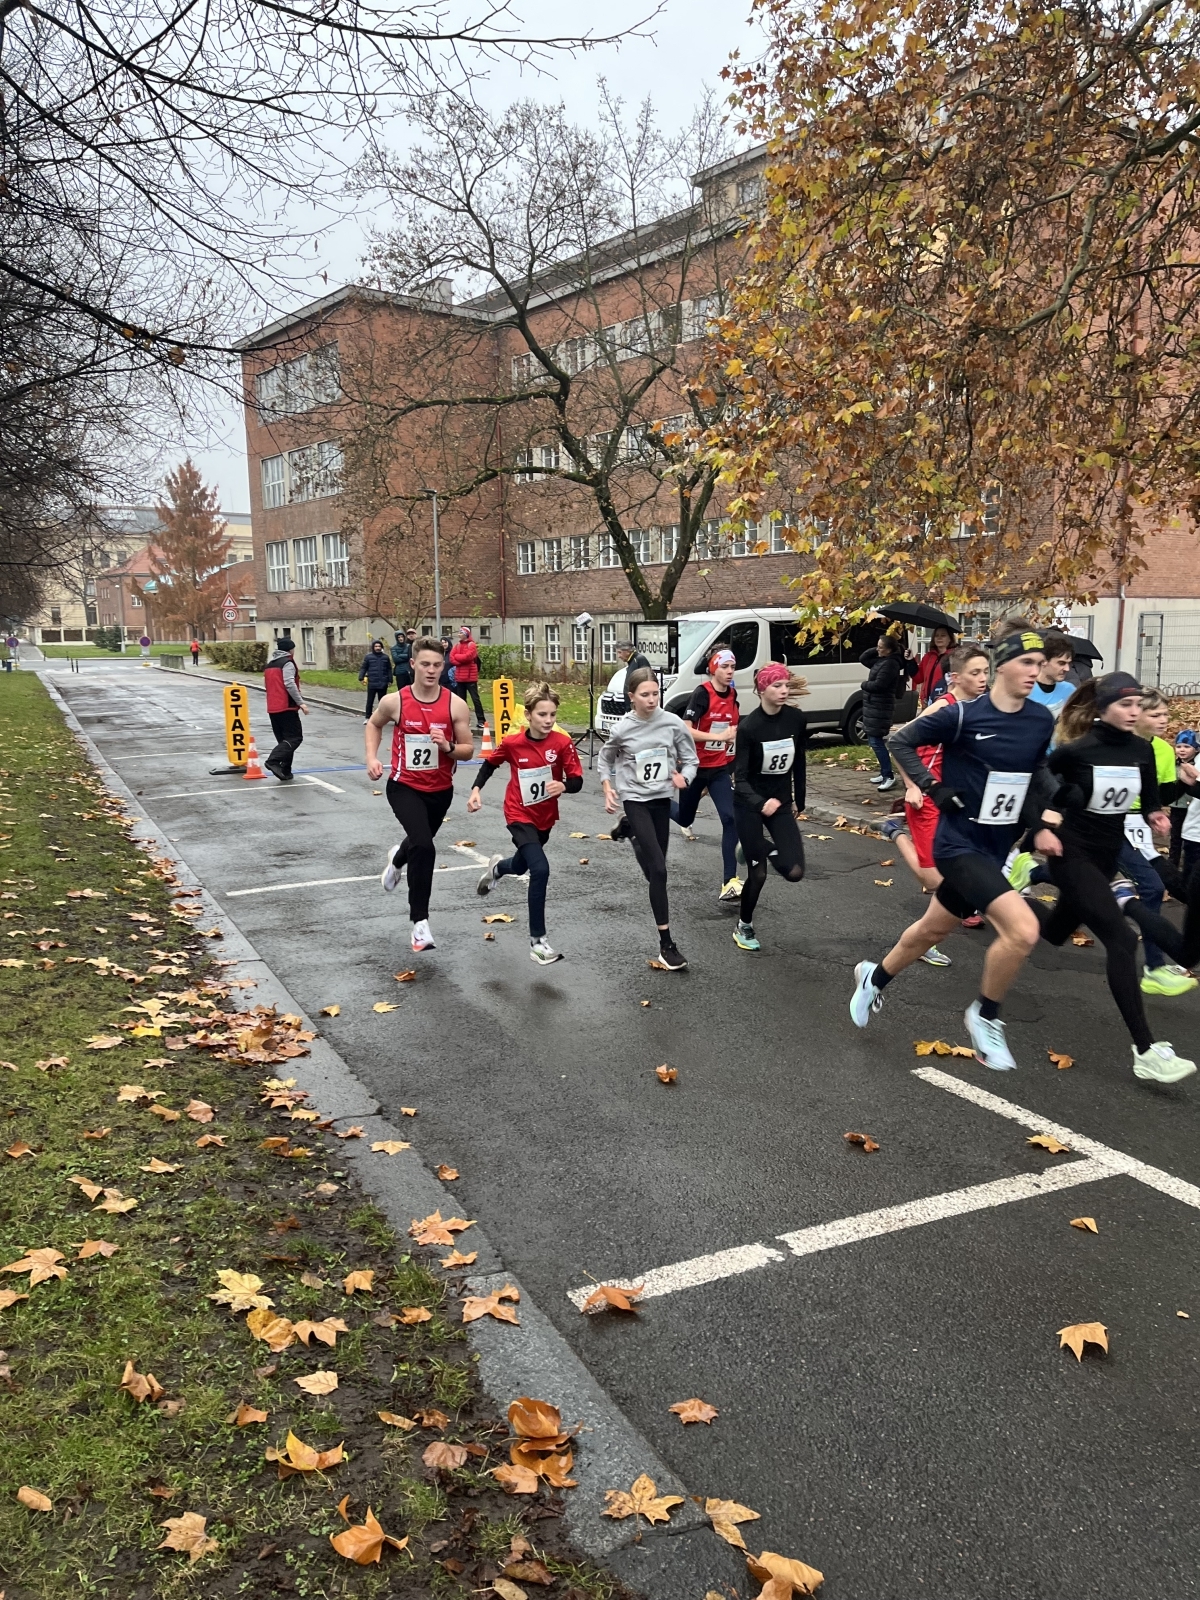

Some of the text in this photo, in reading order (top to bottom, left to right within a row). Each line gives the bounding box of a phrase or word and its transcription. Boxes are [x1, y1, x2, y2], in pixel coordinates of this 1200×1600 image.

[638, 641, 668, 654] 00:00:03
[499, 682, 511, 739] STAR
[230, 688, 245, 761] START
[412, 748, 431, 766] 82
[769, 753, 788, 771] 88
[643, 762, 662, 781] 87
[530, 780, 546, 801] 91
[1100, 786, 1129, 809] 90
[991, 793, 1016, 818] 84
